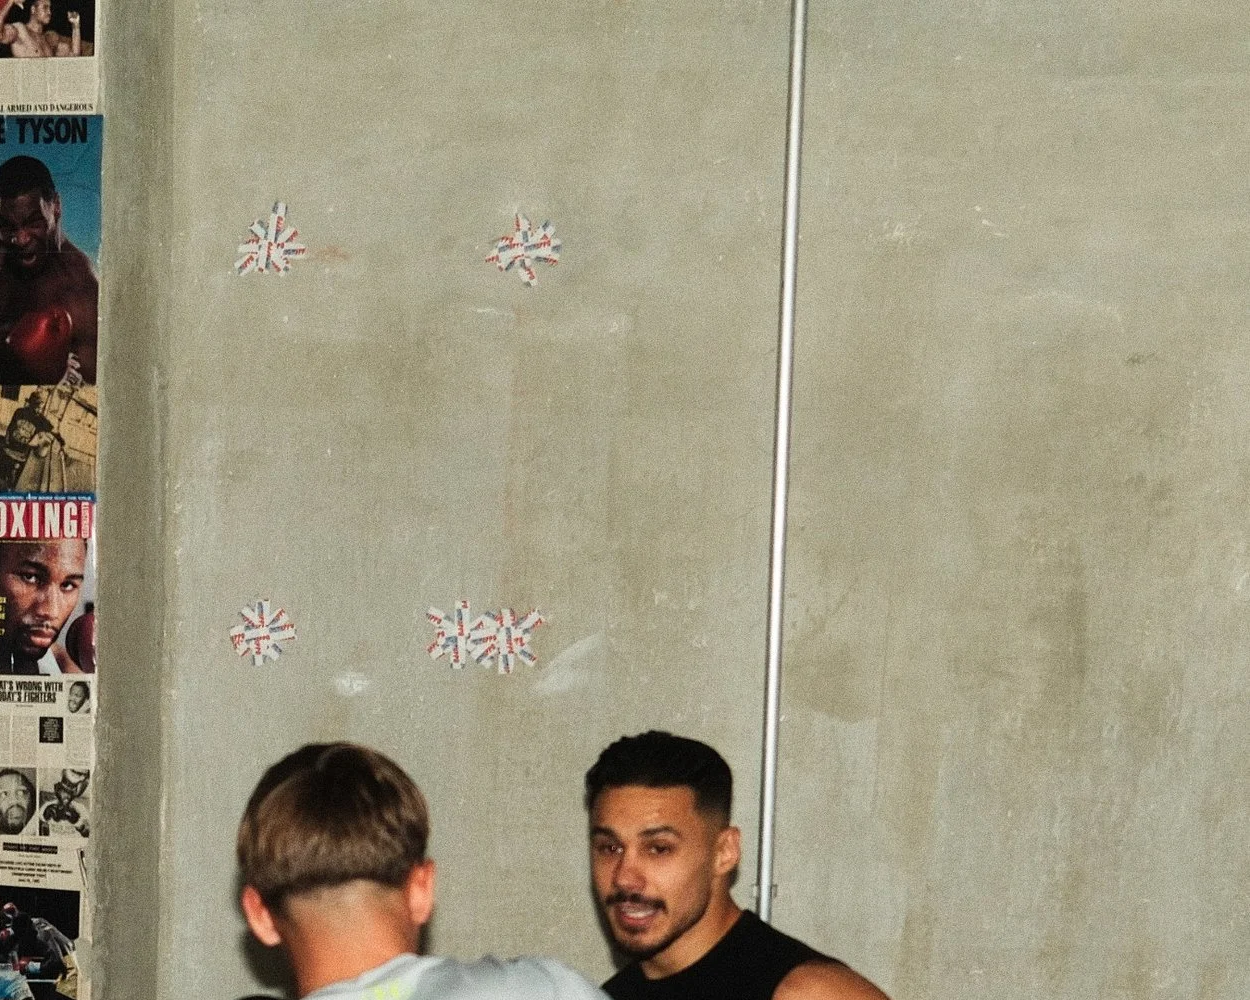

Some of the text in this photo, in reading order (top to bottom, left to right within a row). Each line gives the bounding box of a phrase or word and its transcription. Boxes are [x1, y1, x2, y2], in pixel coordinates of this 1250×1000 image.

[6, 104, 32, 112] ARMED
[34, 103, 48, 112] AND
[50, 103, 94, 111] DANGEROUS
[16, 117, 88, 144] TYSON
[15, 680, 42, 691] WRONG
[44, 681, 63, 692] WITH
[24, 692, 57, 703] FIGHTERS
